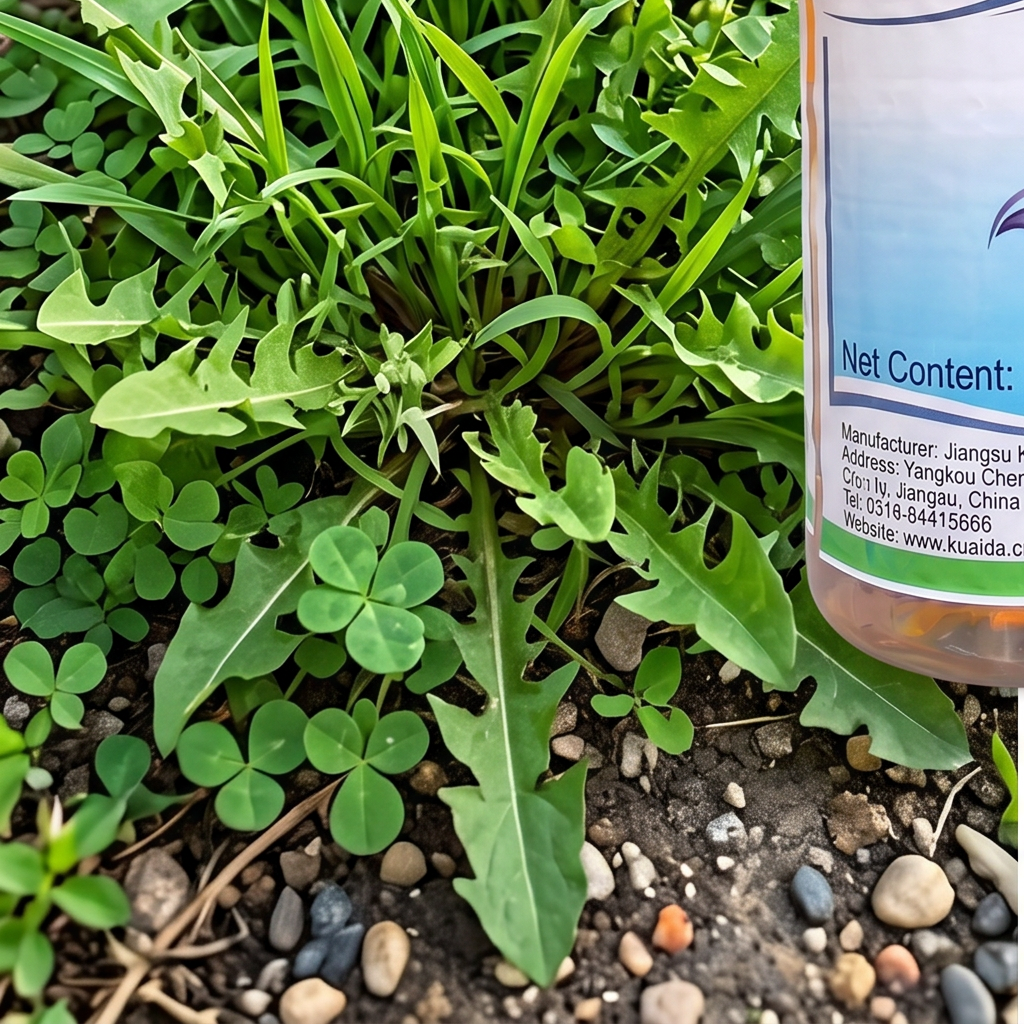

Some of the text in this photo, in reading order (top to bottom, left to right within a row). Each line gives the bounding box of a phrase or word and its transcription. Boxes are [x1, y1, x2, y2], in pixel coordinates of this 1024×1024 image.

[842, 339, 881, 379] Net
[888, 350, 1013, 391] Content:
[841, 422, 938, 459] Manufacturer:
[944, 442, 1011, 467] Jiangsu
[841, 445, 900, 476] Address:
[904, 459, 976, 487] Yangkou
[842, 487, 863, 511] Tel:
[896, 481, 963, 510] Jiangau,
[968, 491, 1020, 510] China
[843, 509, 900, 544] Website:
